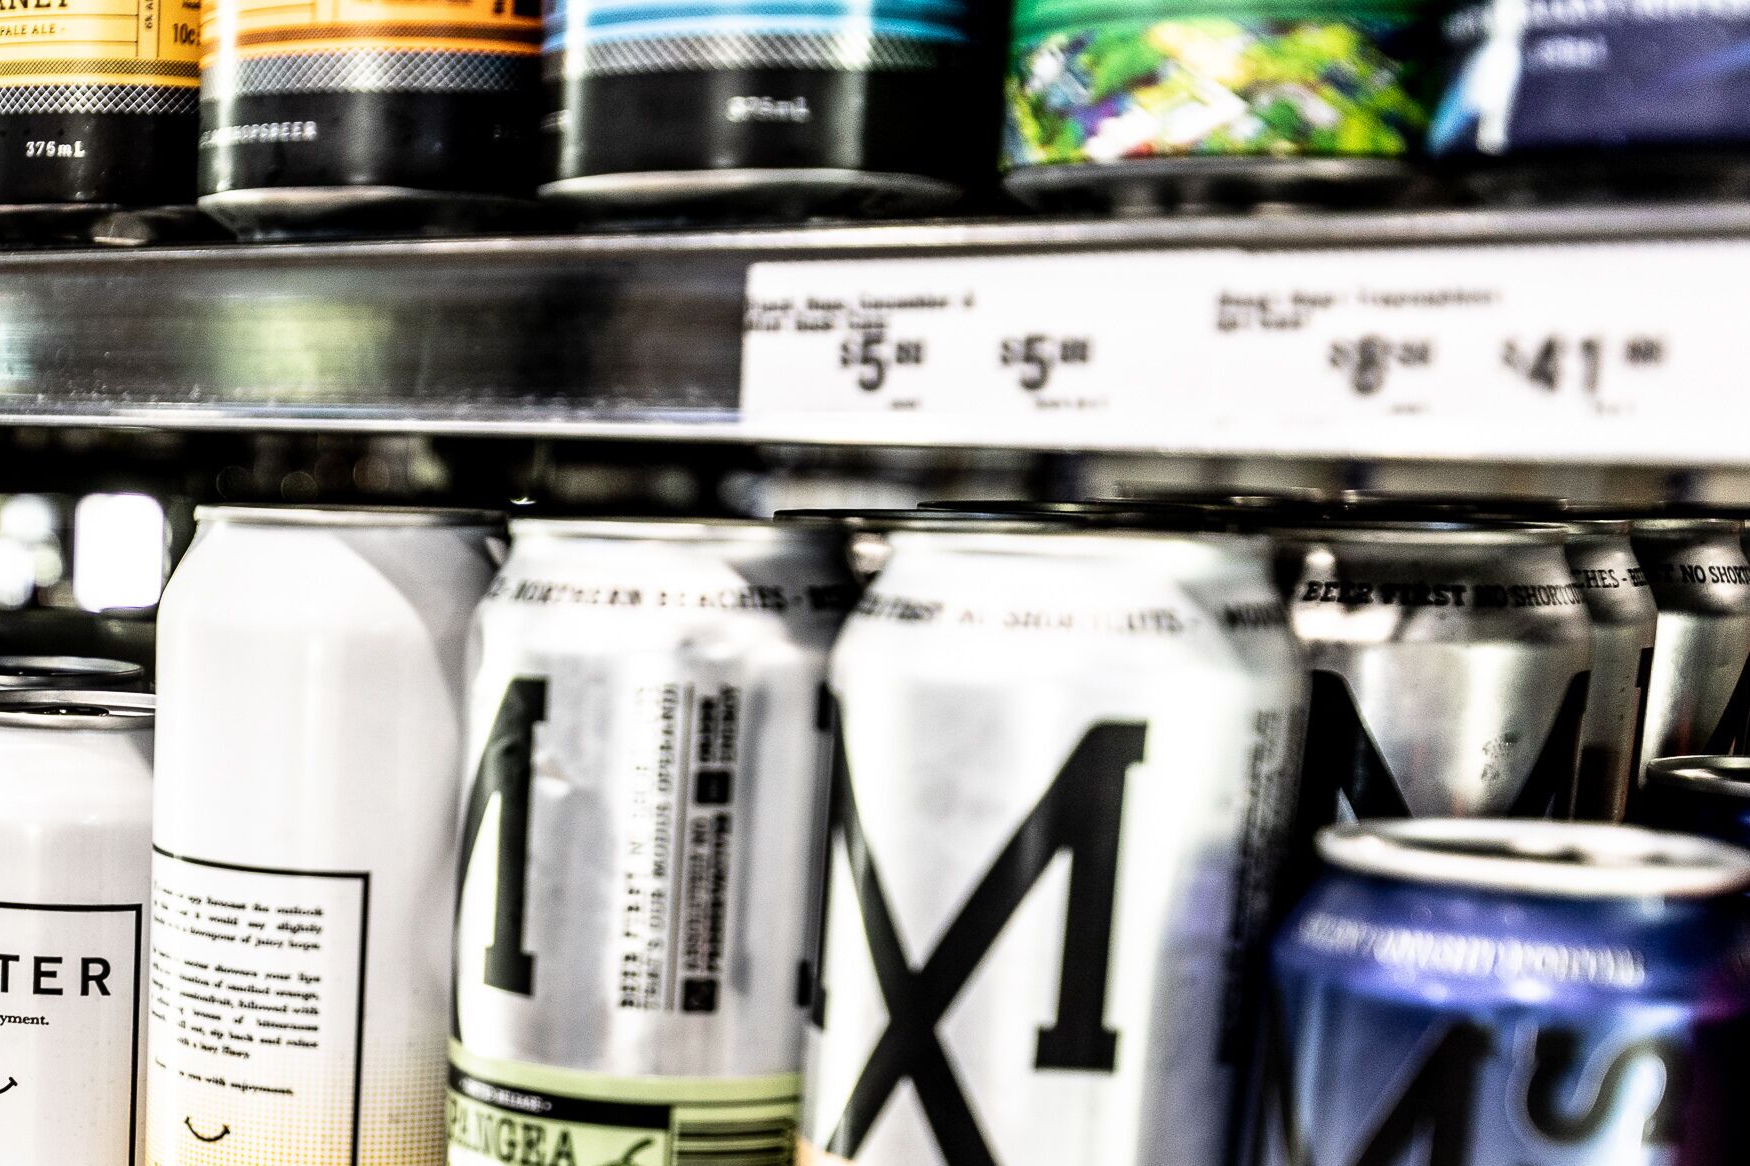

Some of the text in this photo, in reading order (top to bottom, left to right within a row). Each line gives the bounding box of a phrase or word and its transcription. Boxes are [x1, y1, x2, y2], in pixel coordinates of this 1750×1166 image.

[0, 24, 27, 38] PALE
[31, 22, 56, 36] ALE
[25, 140, 86, 159] 375mL
[1682, 564, 1706, 585] NO
[1304, 580, 1508, 608] BEER FIRST NO
